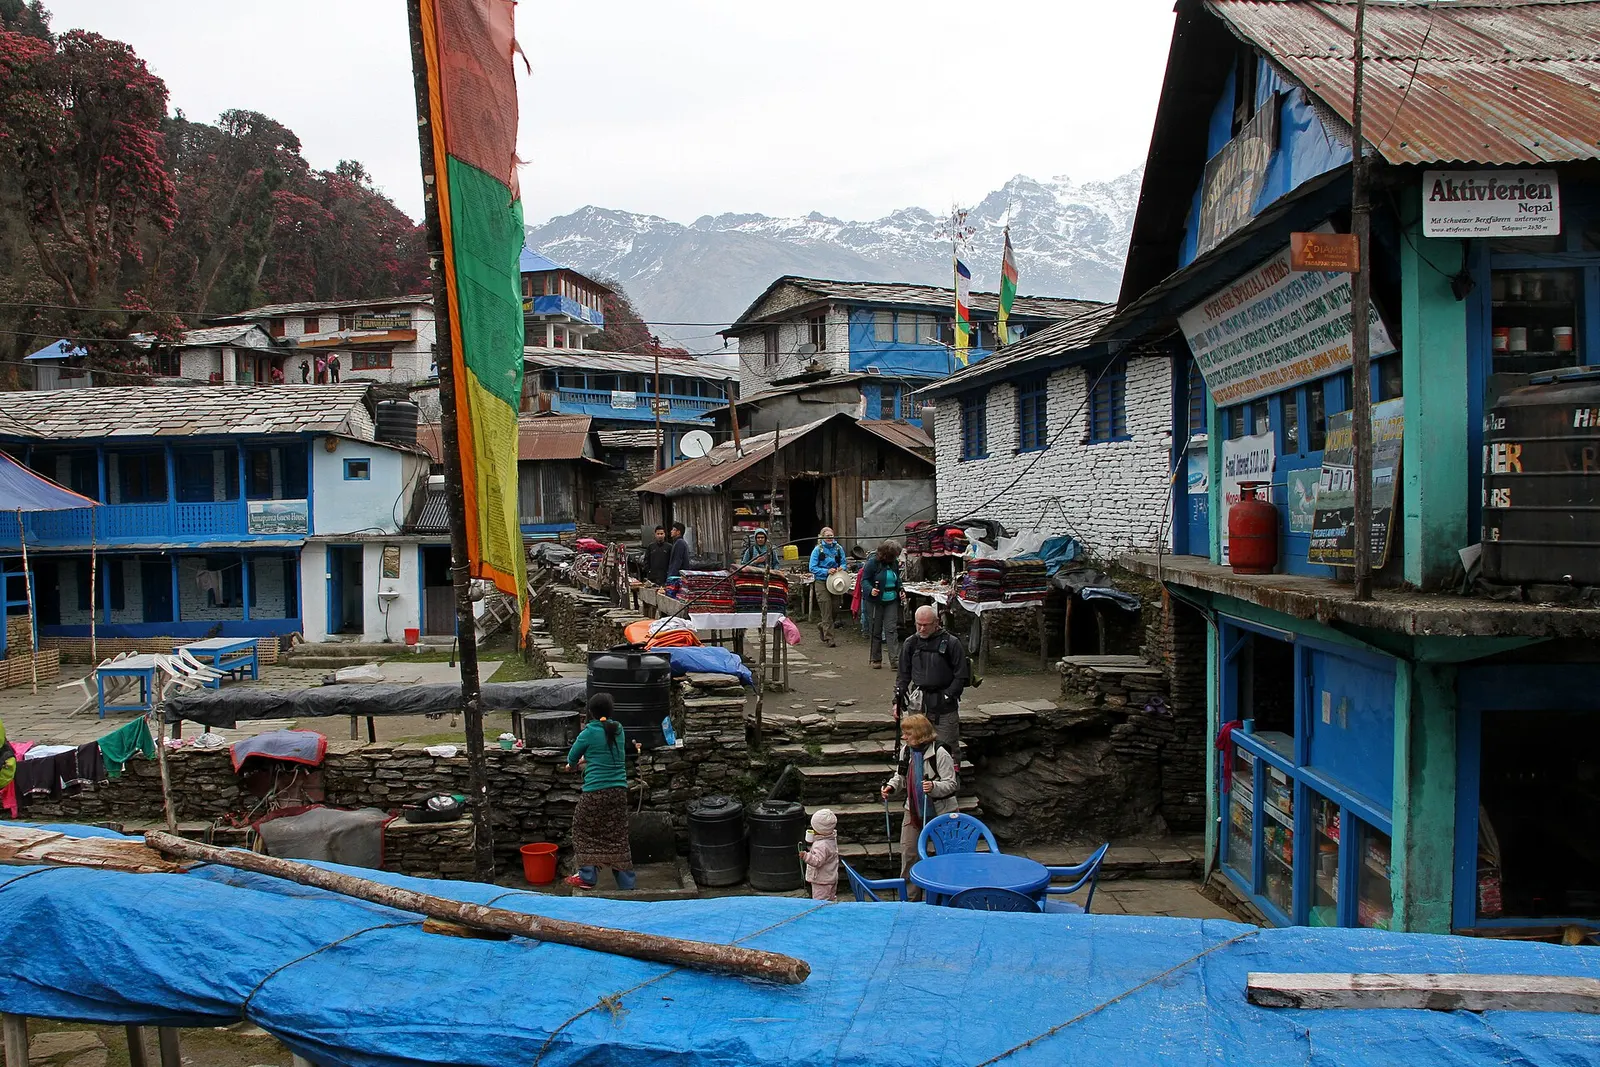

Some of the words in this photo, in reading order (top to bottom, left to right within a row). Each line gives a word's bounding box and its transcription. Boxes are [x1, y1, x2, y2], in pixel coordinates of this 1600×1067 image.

[1429, 178, 1553, 202] Aktivferien
[1518, 202, 1553, 215] Nepal
[1314, 245, 1348, 254] DIAMIR
[1233, 274, 1266, 309] SPECIAL
[1261, 257, 1290, 289] ITEMS
[277, 511, 291, 522] Guest
[291, 511, 305, 522] House
